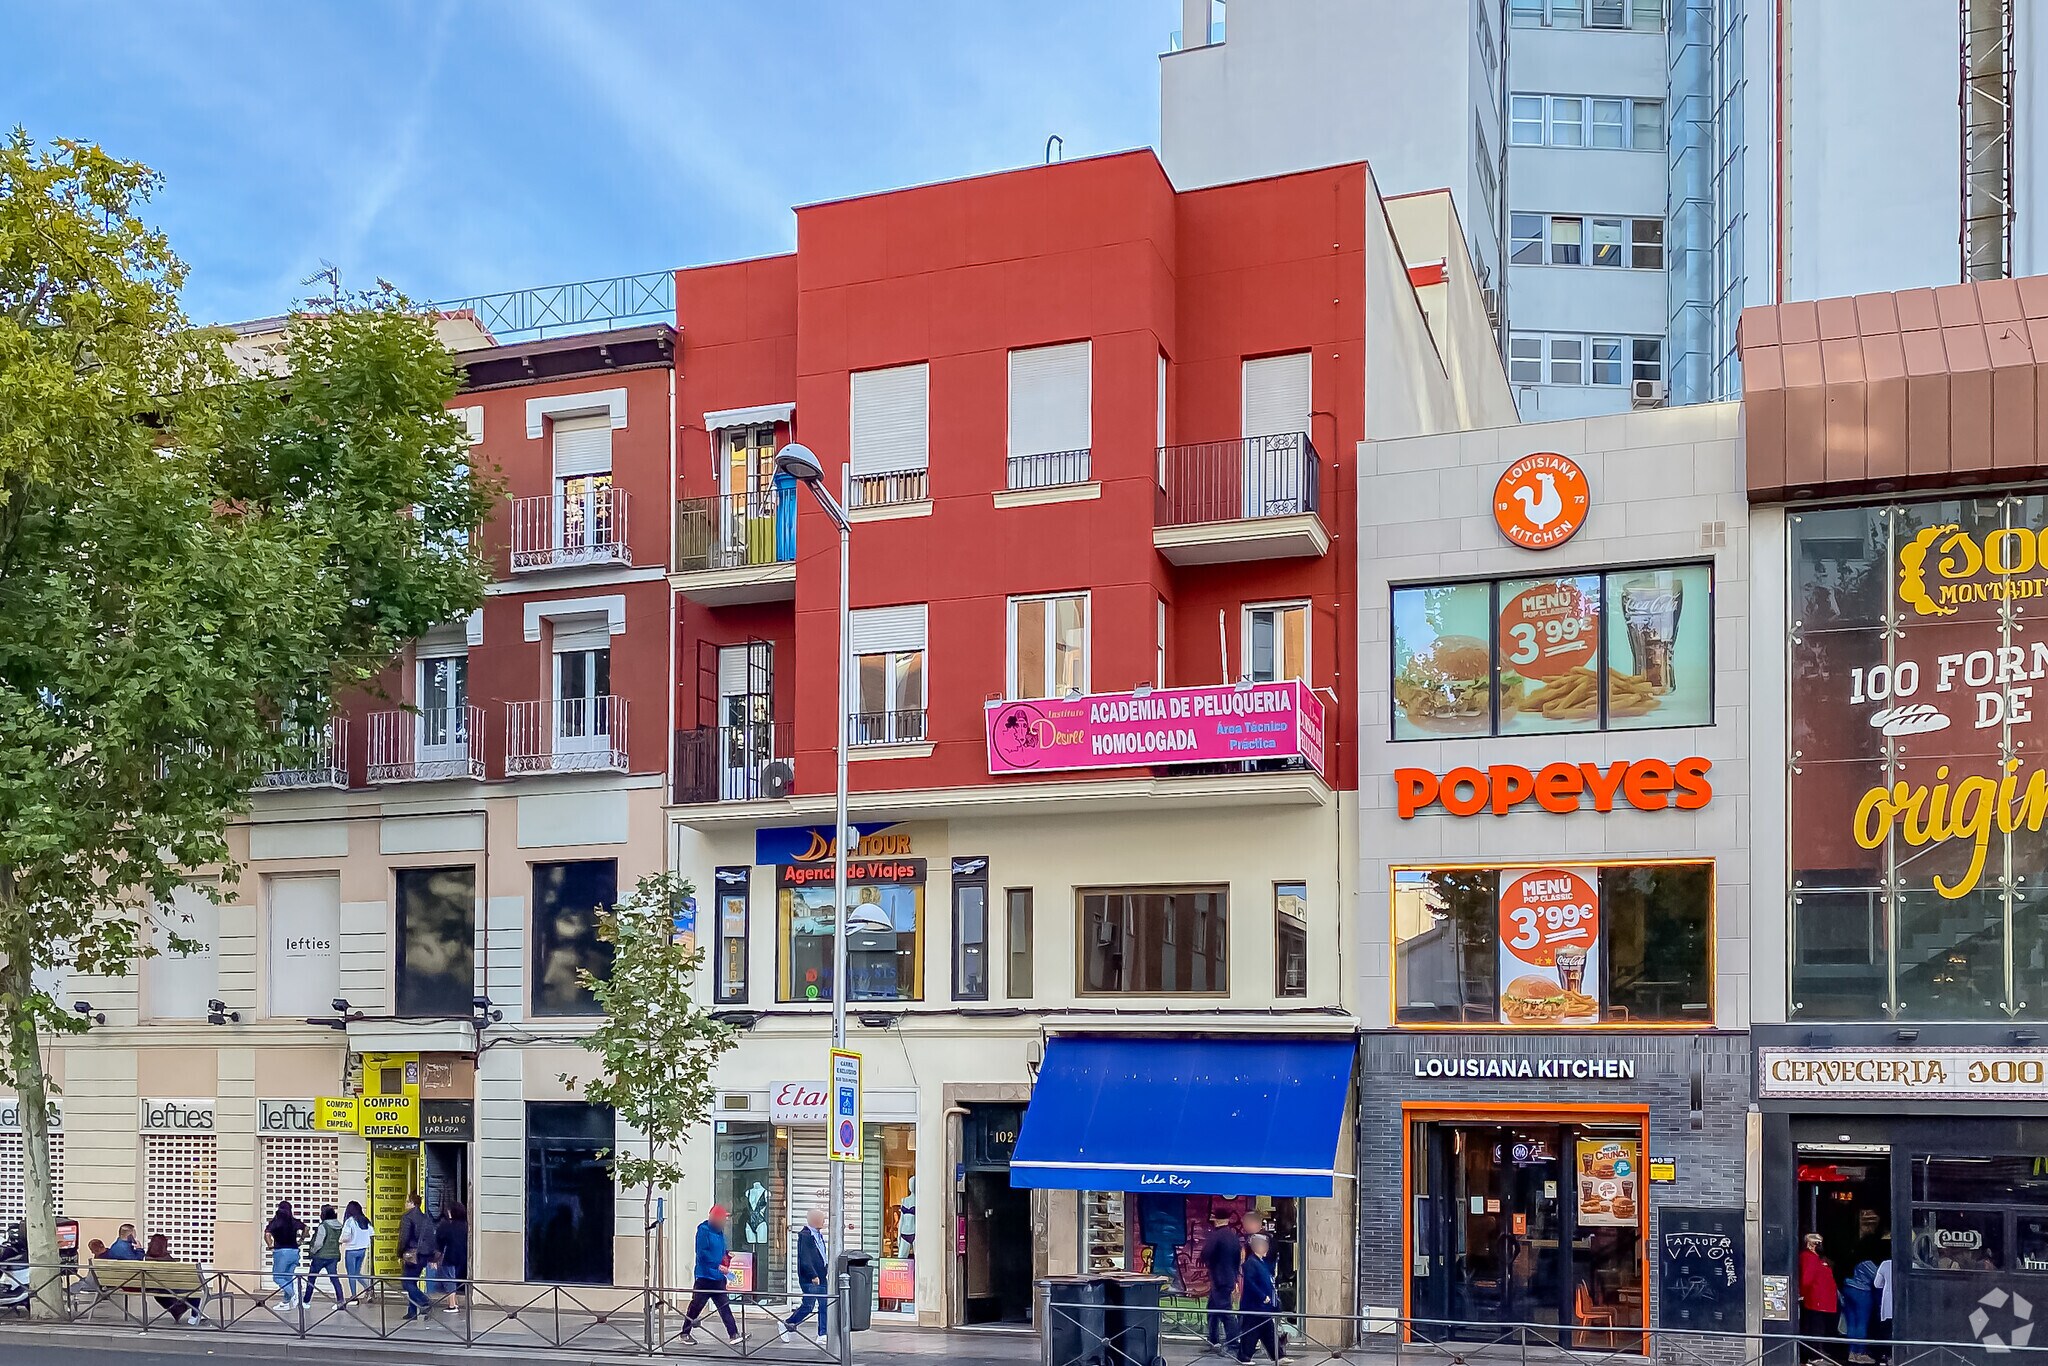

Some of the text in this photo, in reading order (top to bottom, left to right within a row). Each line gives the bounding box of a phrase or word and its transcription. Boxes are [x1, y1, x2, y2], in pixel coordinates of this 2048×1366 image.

[1505, 457, 1577, 485] LOUISIANA
[1498, 502, 1508, 510] 19
[1574, 495, 1585, 504] 72
[1509, 520, 1573, 543] KITCHEN
[1939, 577, 2048, 605] MONTADI
[1850, 661, 1919, 705] 100
[1048, 709, 1084, 718] Instituto
[1090, 695, 1168, 724] ACADEMIA
[1171, 695, 1191, 718] DE
[1193, 690, 1292, 718] PELUQUERIA
[1974, 685, 2033, 729] DE
[1091, 728, 1198, 755] HOMOLOGADA
[785, 862, 915, 884] Agenci de Viajes
[1522, 874, 1572, 896] MENÚ
[1523, 893, 1573, 904] POP CLASSIC
[286, 937, 331, 950] lefties
[1414, 1058, 1635, 1078] LOUISIANA KITCHEN
[1771, 1058, 1948, 1087] CERVECERIA
[326, 1100, 354, 1109] COMPRO
[363, 1098, 410, 1108] COMPRO
[143, 1102, 213, 1129] lefties
[262, 1103, 315, 1130] leftie
[332, 1110, 347, 1118] ORO
[375, 1111, 399, 1121] ORO
[326, 1119, 353, 1128] EMPEÑO
[364, 1123, 409, 1135] EMPEÑO
[994, 1131, 1014, 1143] 102
[1141, 1174, 1192, 1189] Lola Rey
